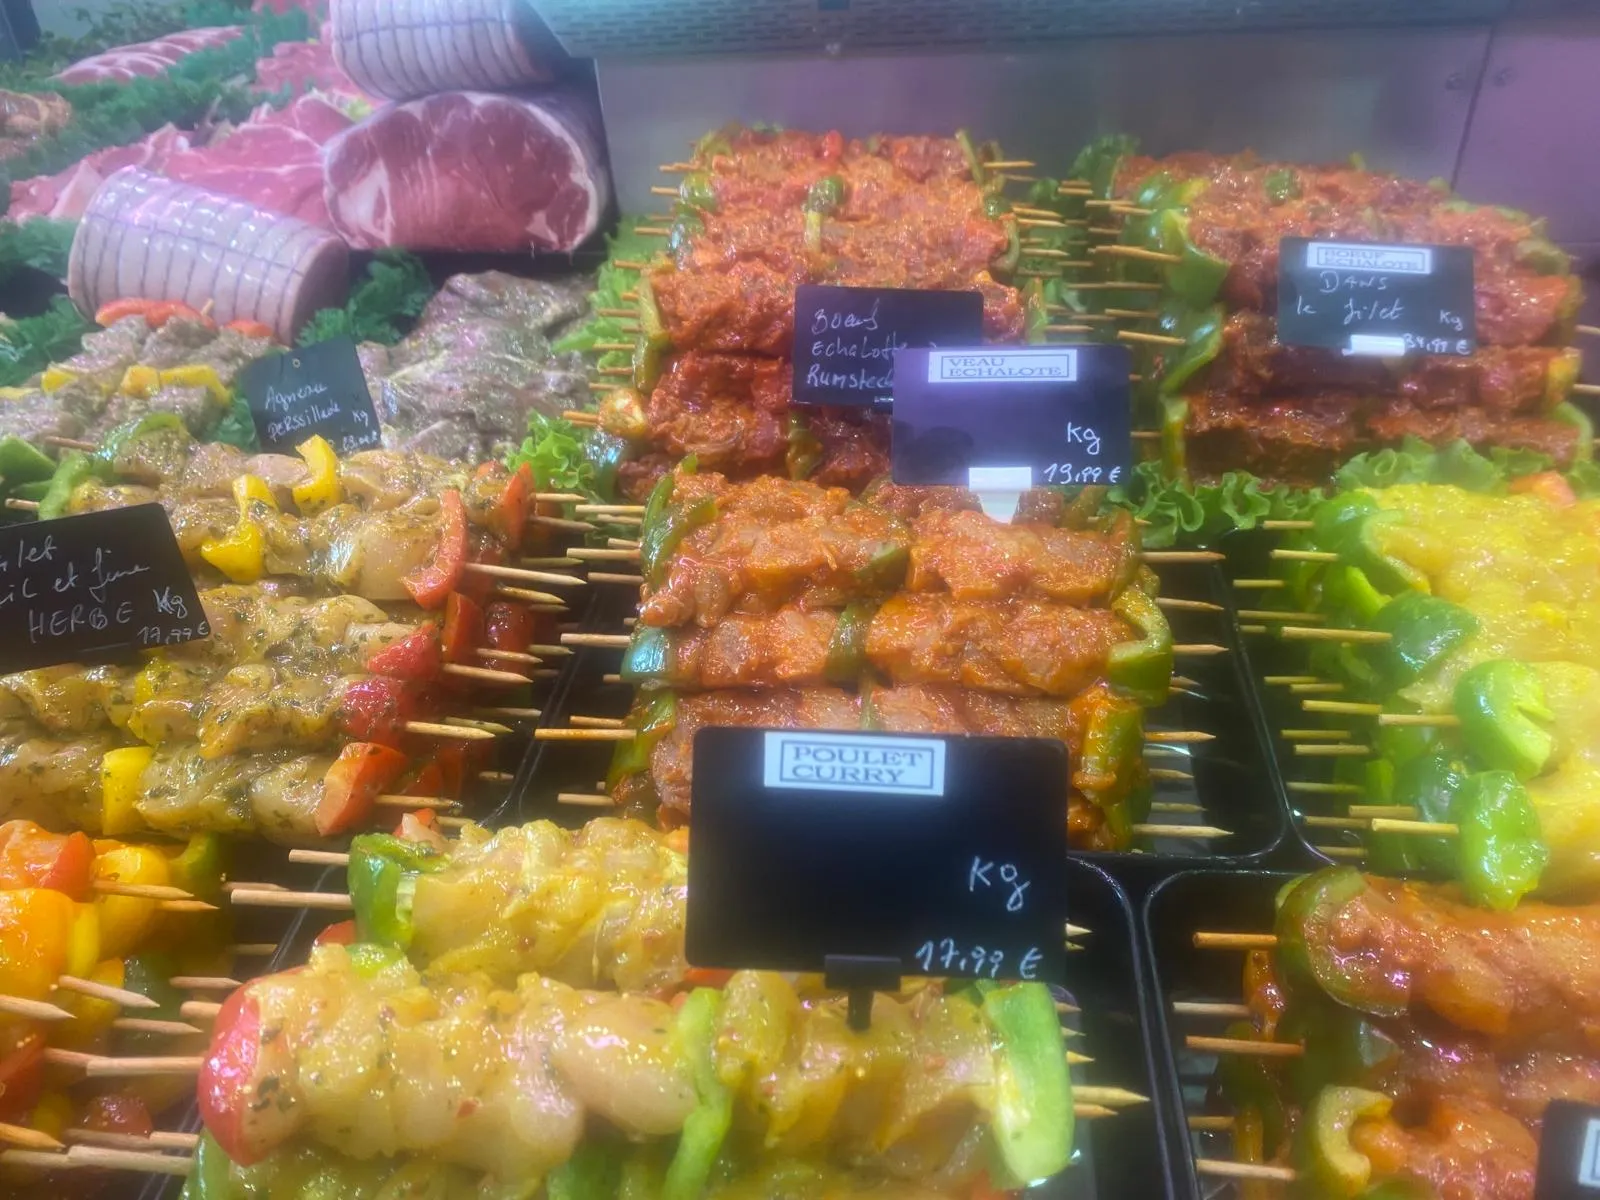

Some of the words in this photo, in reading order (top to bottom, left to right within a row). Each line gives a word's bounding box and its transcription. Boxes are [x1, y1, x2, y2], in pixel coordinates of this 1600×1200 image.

[1343, 298, 1404, 325] filet
[1439, 309, 1463, 331] Kg
[949, 357, 1005, 367] VEAU
[949, 366, 1062, 378] ECHALOTE
[1044, 463, 1102, 484] 19,99
[1109, 466, 1121, 483] €
[54, 562, 78, 592] et
[29, 601, 133, 643] HERBE
[153, 586, 188, 619] Kg
[792, 746, 923, 767] POULET
[791, 764, 905, 784] CURRY
[969, 856, 1031, 911] Kg
[915, 938, 1004, 978] 17,99
[1020, 948, 1043, 979] €
